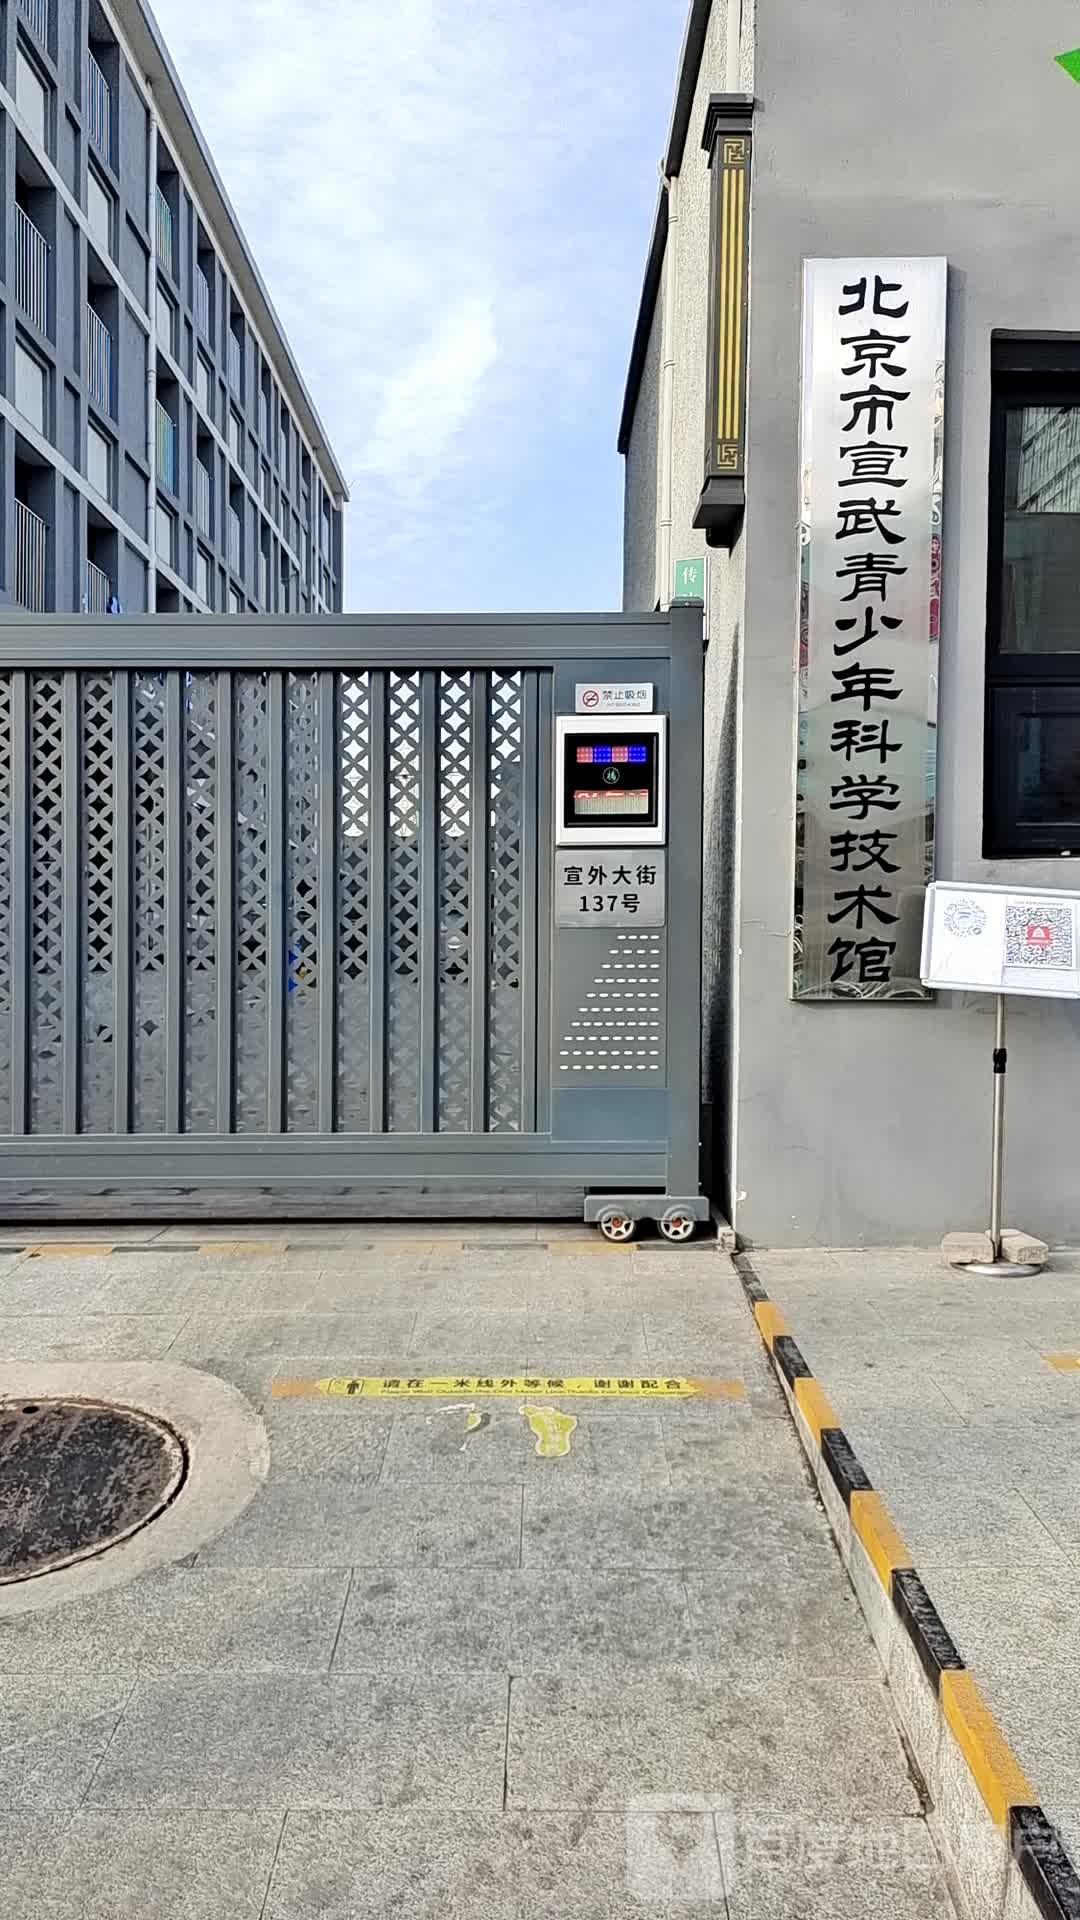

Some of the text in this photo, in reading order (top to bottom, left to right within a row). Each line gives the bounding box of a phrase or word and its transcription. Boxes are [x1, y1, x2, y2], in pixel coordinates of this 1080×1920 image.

[827, 274, 911, 984] 北京市宣武青少年科学技术馆
[602, 689, 647, 700] 禁止吸烟
[563, 865, 657, 886] 宣外大街
[579, 893, 641, 913] 137号
